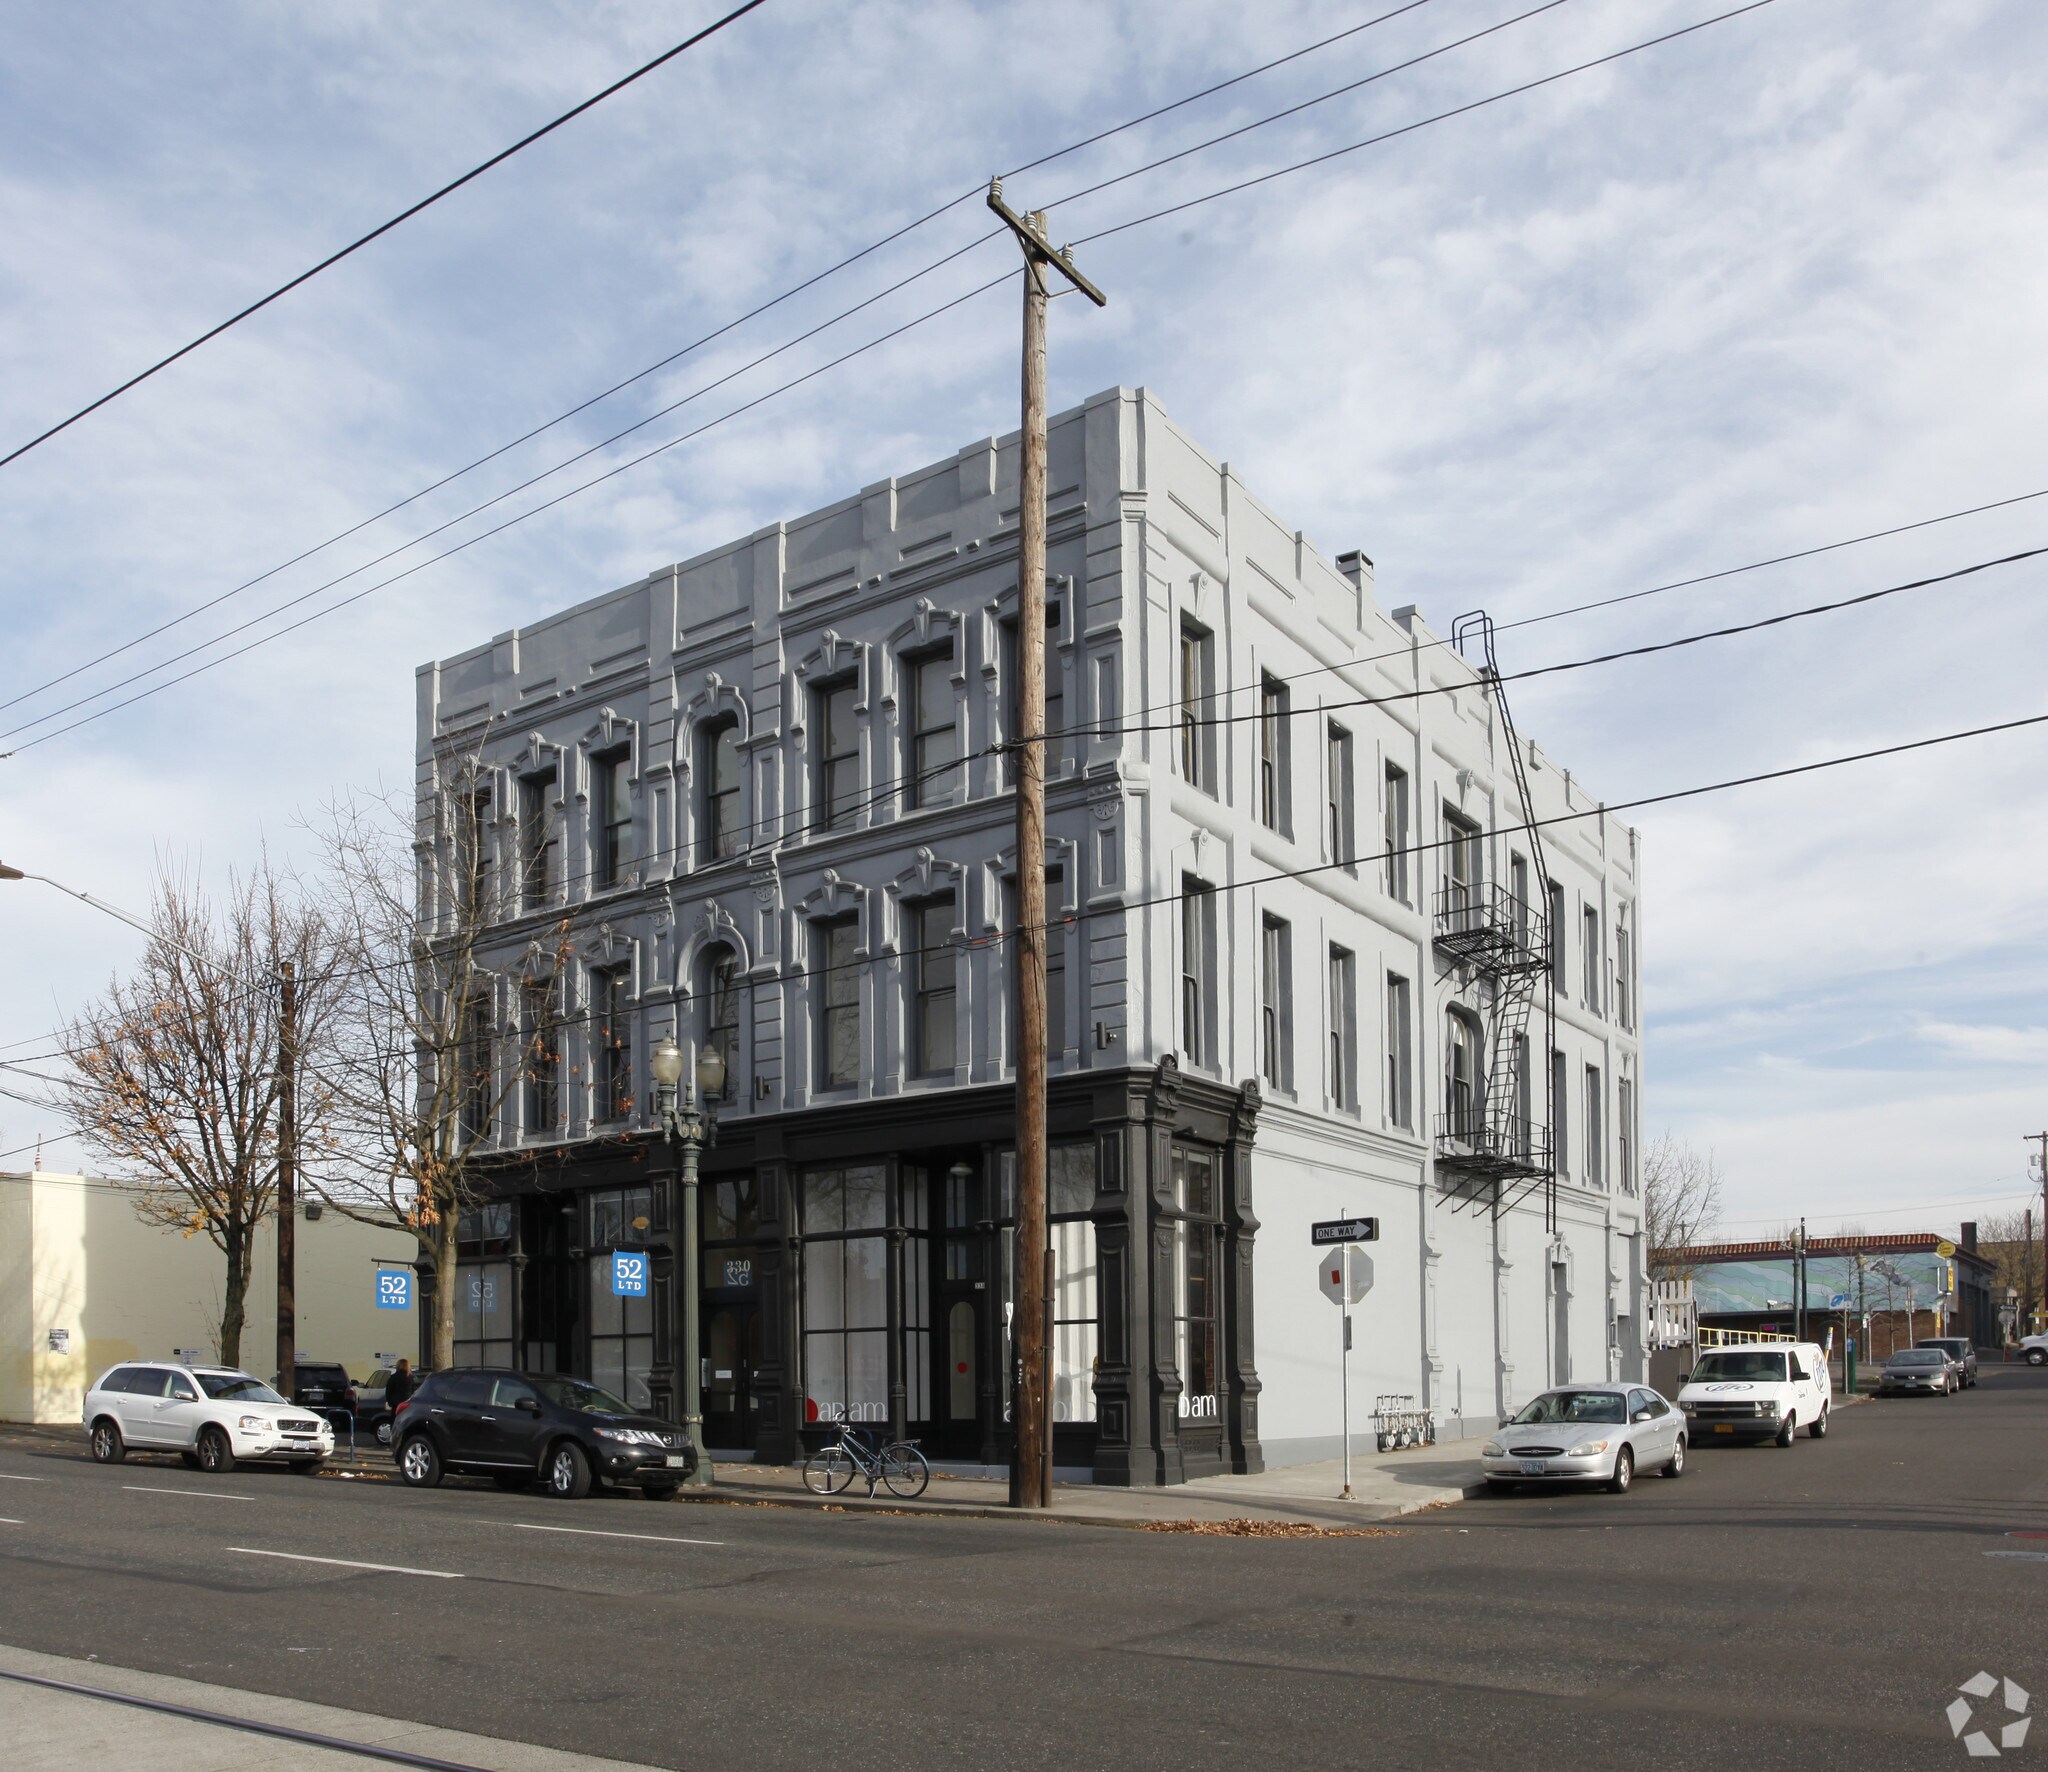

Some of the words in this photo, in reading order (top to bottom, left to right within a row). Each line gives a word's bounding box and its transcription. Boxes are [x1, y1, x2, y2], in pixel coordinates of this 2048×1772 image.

[1317, 1228, 1334, 1238] ONE
[1337, 1226, 1355, 1236] WAY
[616, 1258, 642, 1279] 52
[380, 1276, 406, 1295] 52
[618, 1280, 641, 1291] LTD
[382, 1295, 406, 1305] LTD
